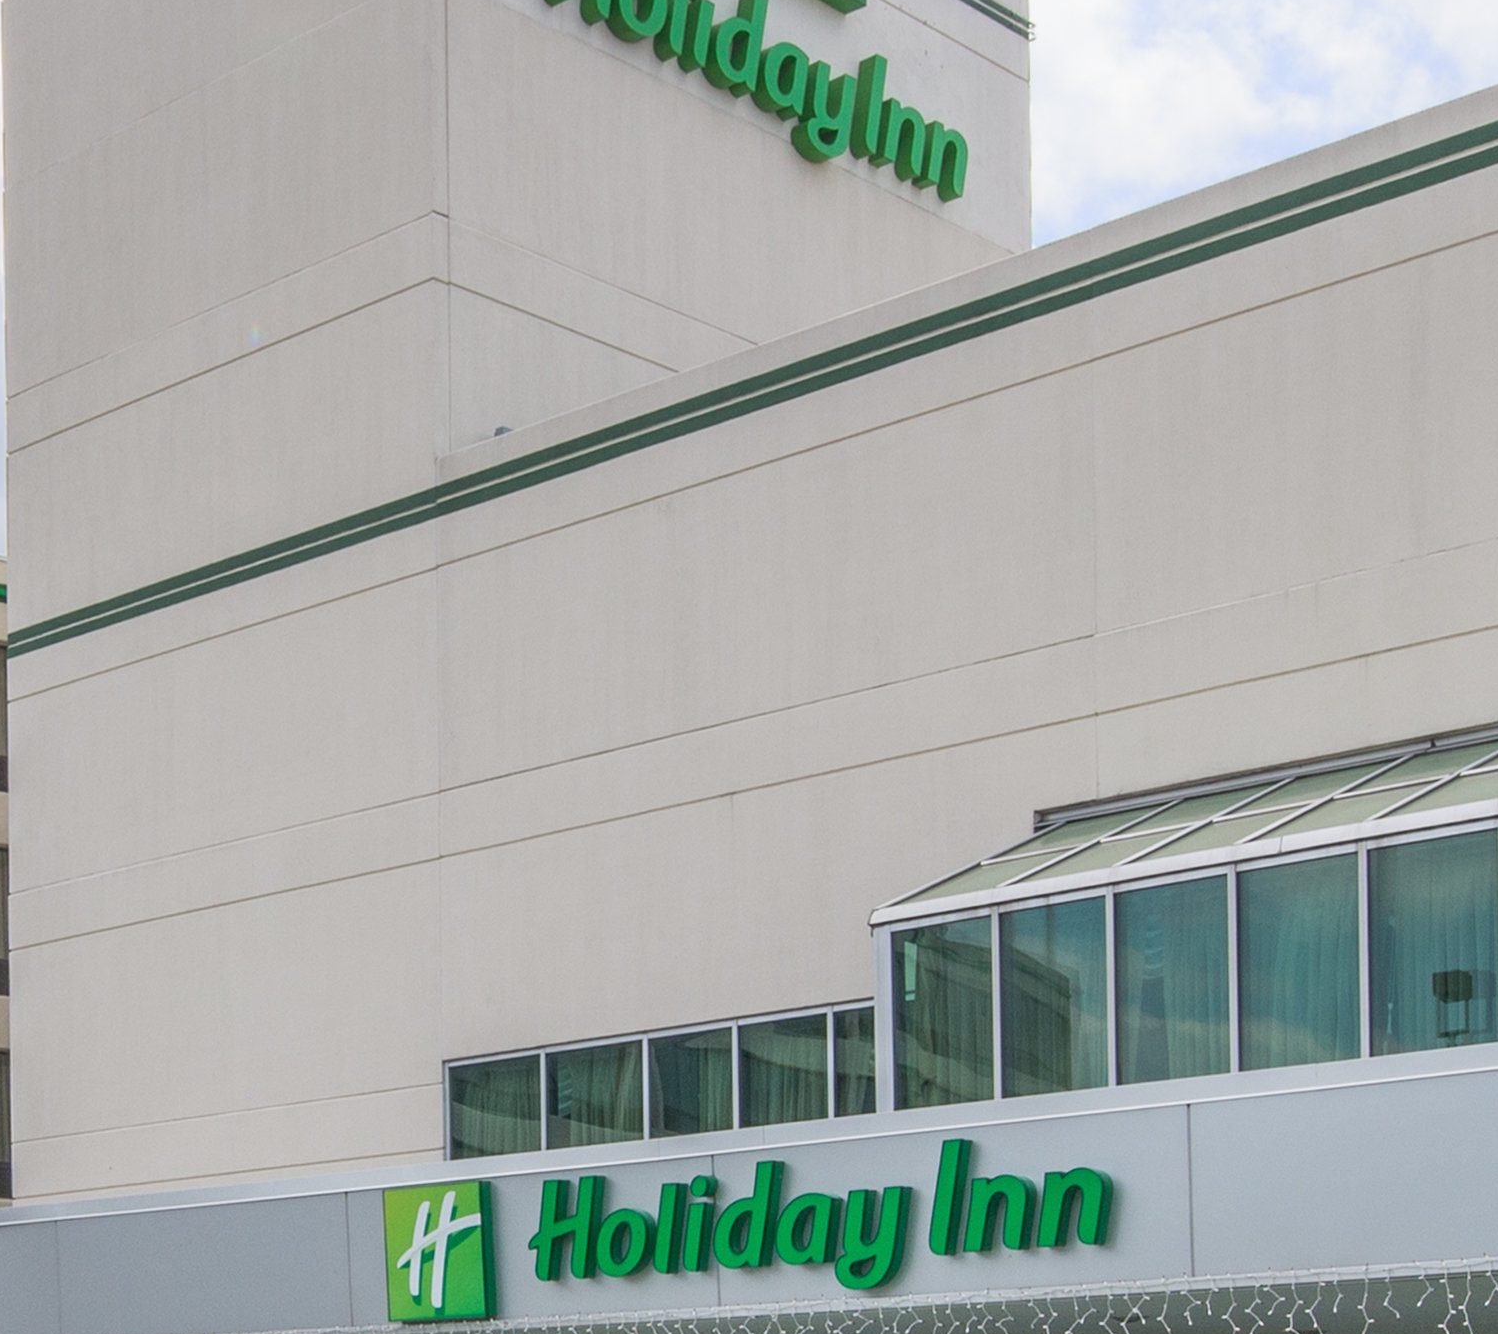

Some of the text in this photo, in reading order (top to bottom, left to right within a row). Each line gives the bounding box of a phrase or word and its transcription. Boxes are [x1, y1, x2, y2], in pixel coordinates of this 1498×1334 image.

[850, 54, 969, 204] Inn
[528, 1138, 1115, 1291] Holiday Inn
